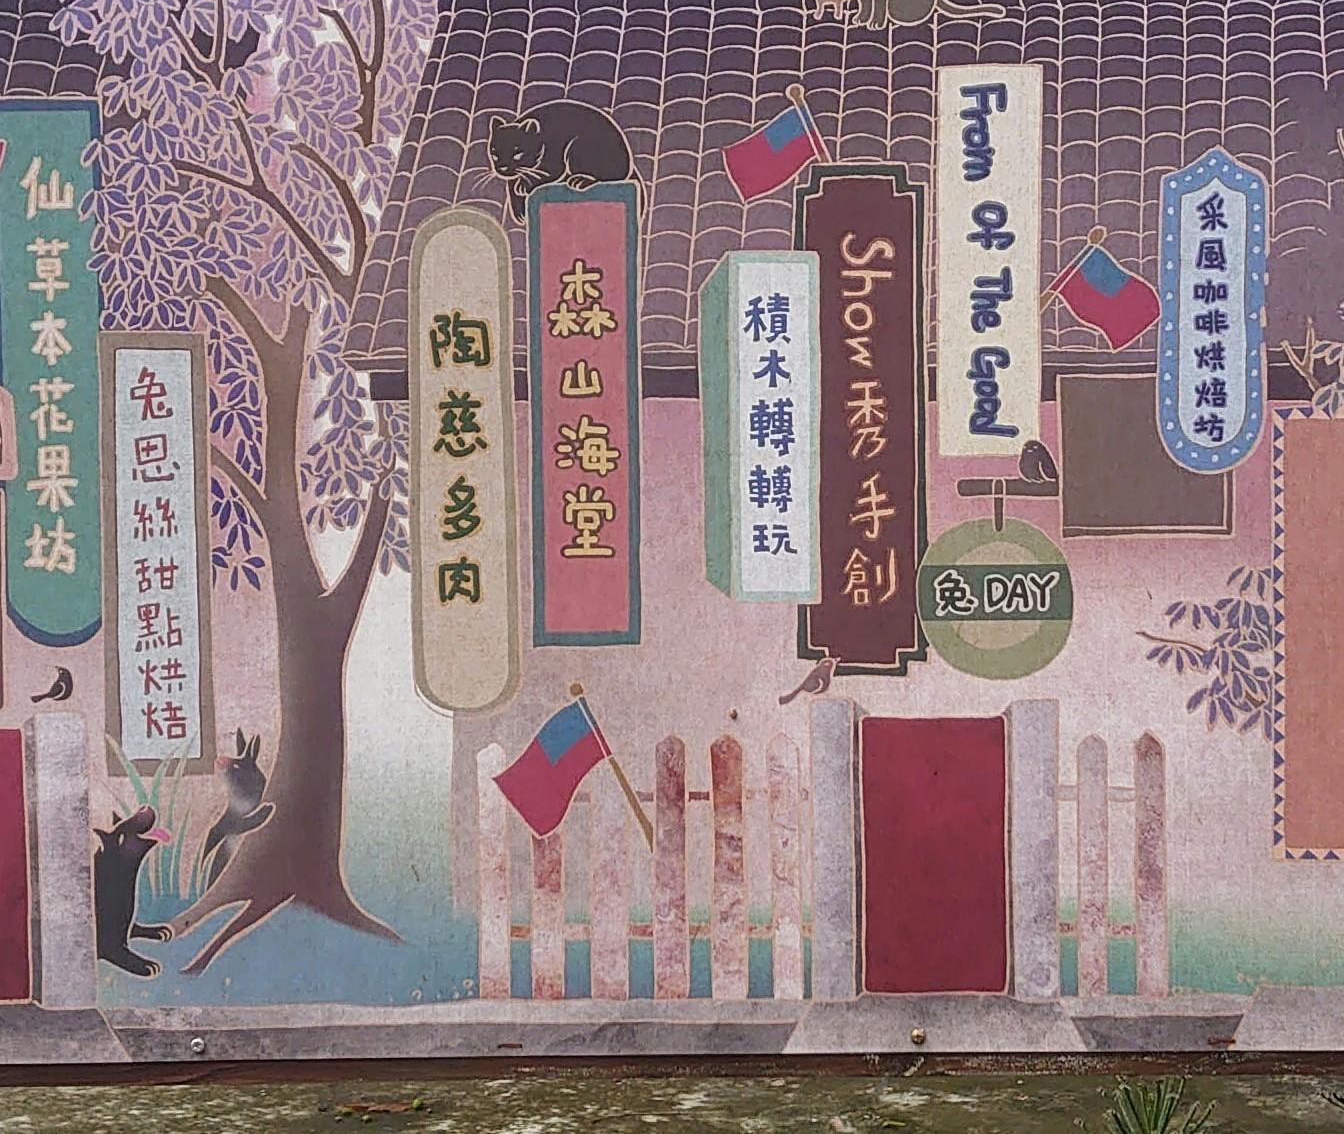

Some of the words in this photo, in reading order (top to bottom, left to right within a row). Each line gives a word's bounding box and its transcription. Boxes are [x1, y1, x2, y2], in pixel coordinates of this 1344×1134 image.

[959, 82, 1008, 183] From
[20, 156, 77, 574] 仙草本花果坊
[548, 258, 622, 560] 森山海堂
[743, 292, 799, 557] 積木轉轉玩
[966, 346, 1020, 438] Good
[969, 265, 1014, 334] The
[1193, 190, 1231, 444] 采風咖啡烘焙坊
[428, 309, 492, 605] 陶慈多肉
[984, 571, 1060, 614] DAY
